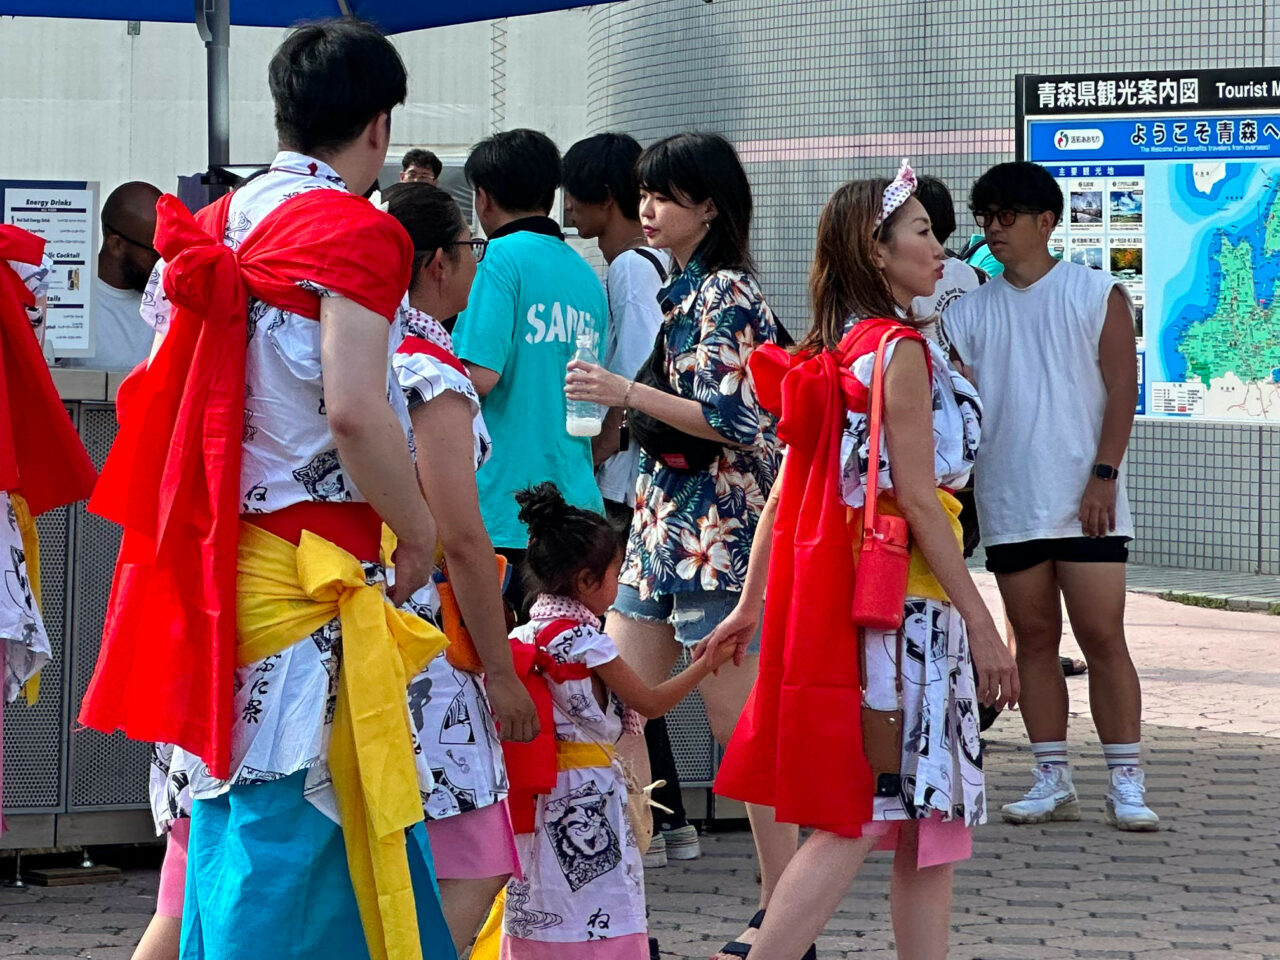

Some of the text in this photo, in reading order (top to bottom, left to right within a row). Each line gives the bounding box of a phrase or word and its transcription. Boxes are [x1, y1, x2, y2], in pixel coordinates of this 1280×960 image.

[1037, 78, 1199, 108] 青森県観光案内図
[1215, 81, 1268, 99] Tourist
[1130, 120, 1280, 145] ようこそ青森へ
[1059, 167, 1114, 176] 主要観光地
[25, 198, 49, 207] Energy
